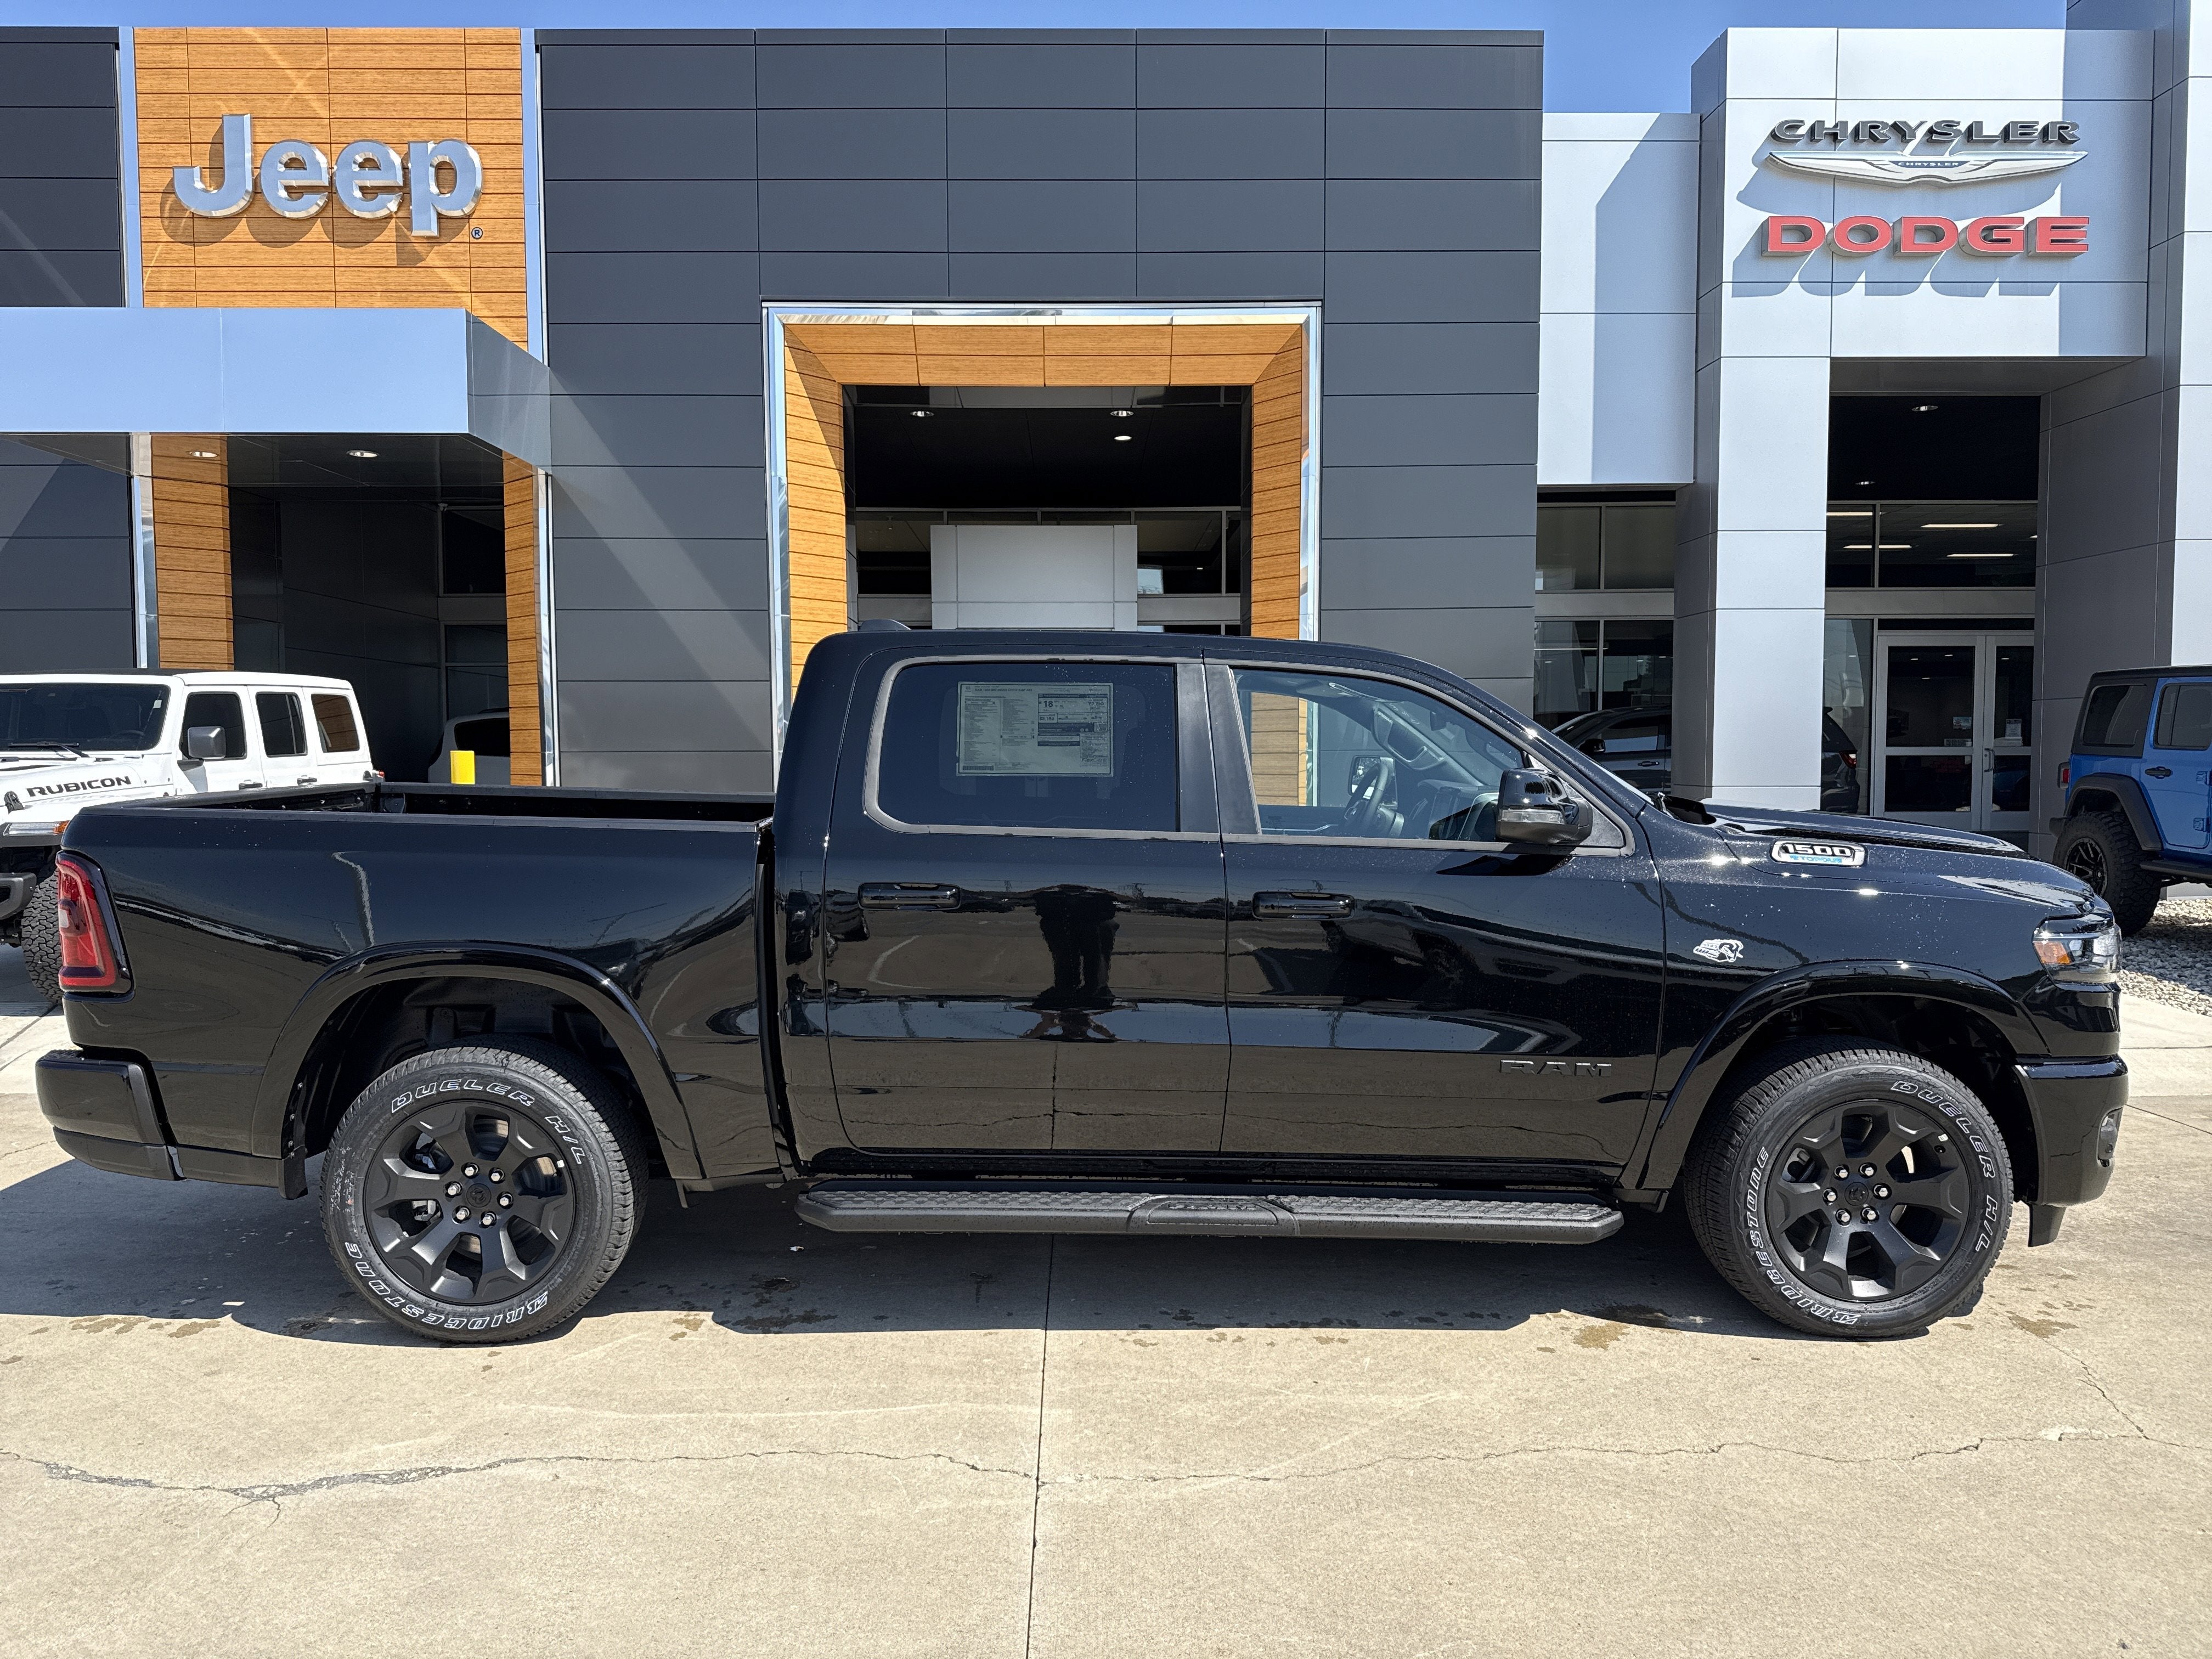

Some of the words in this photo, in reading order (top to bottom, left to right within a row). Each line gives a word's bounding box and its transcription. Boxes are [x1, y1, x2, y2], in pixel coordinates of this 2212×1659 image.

[1772, 120, 2081, 143] CHRYSLER
[172, 113, 483, 238] Jeep
[1765, 216, 2090, 254] DODGE
[26, 776, 132, 797] RUBICON
[1786, 844, 1852, 856] 1500
[1499, 1059, 1612, 1077] RAM
[391, 1079, 535, 1113] DUELER
[544, 1115, 585, 1164] H/L
[1891, 1080, 1995, 1178] DUELER
[1975, 1194, 1997, 1251] H/L
[1747, 1146, 1861, 1325] BRIDGESTONE
[345, 1242, 548, 1329] BRIDGESTONE
